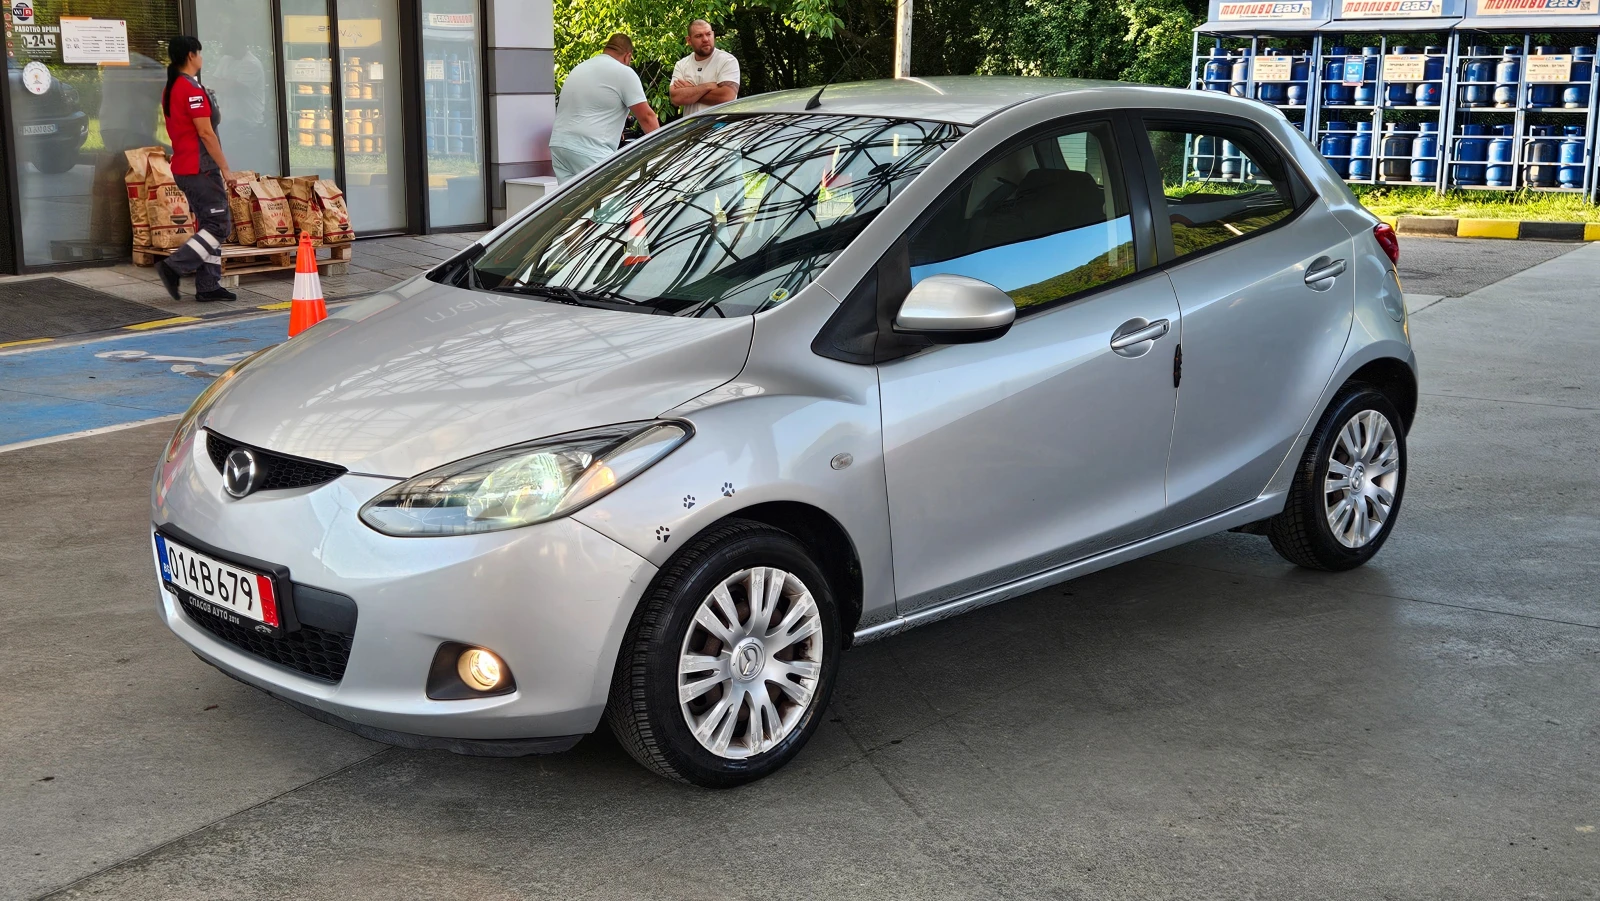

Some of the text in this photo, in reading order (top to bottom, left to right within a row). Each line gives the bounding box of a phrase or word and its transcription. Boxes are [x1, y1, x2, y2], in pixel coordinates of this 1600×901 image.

[163, 562, 171, 574] BG
[189, 597, 240, 625] СПАСОВ АУТО 2016
